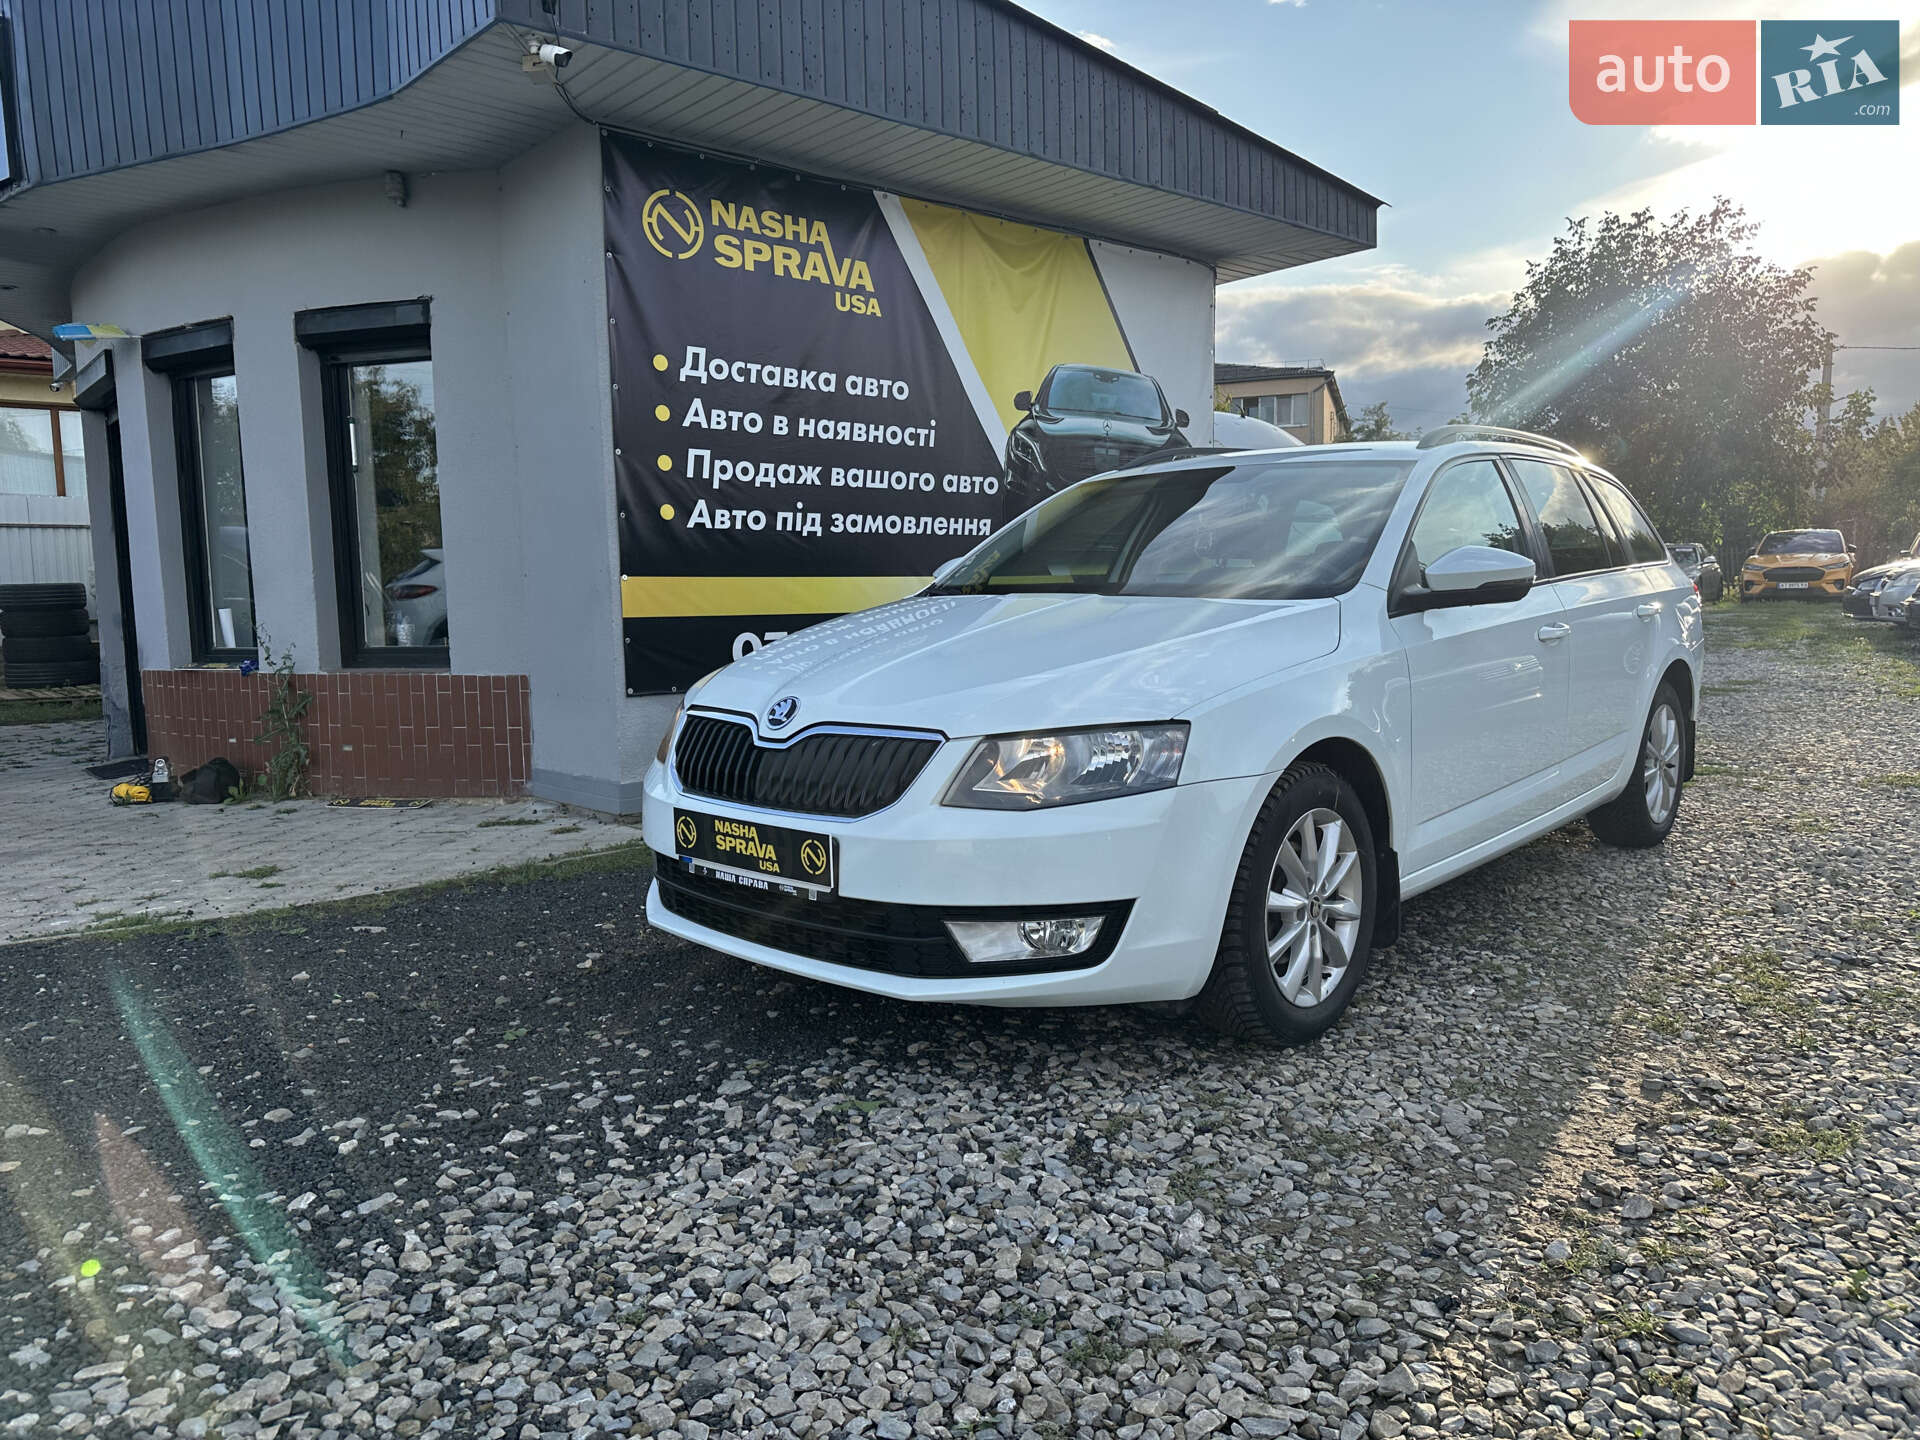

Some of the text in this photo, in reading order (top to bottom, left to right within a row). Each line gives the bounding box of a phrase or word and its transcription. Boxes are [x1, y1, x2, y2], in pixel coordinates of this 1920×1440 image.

[711, 199, 831, 246] NASHA
[713, 234, 875, 292] SPRAVA
[835, 291, 882, 317] USA
[679, 345, 910, 401] Доставка авто
[682, 398, 937, 448] Авто в наявності
[686, 447, 999, 495] Продаж вашого авто
[687, 499, 992, 537] Авто під замовлення
[714, 819, 757, 838] NASHA
[716, 834, 776, 861] SPRAVA
[759, 860, 780, 873] USA
